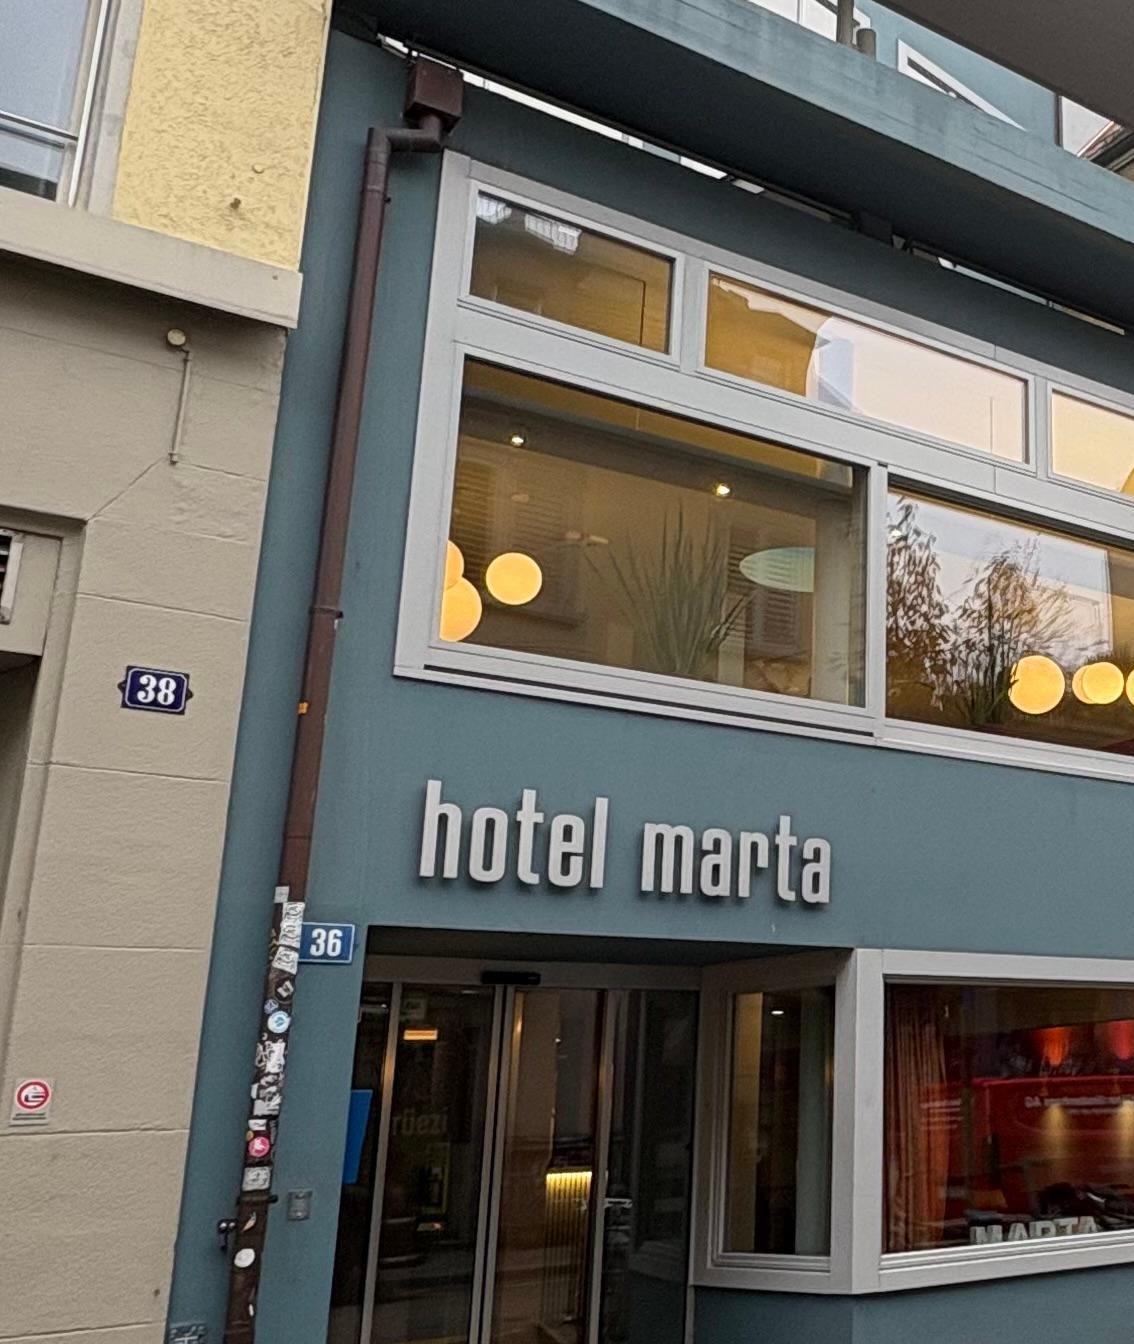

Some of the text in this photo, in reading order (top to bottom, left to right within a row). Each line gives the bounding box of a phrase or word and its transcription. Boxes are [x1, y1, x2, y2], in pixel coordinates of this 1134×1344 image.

[136, 674, 177, 706] 38
[419, 779, 832, 904] hotel marta
[309, 927, 344, 957] 36
